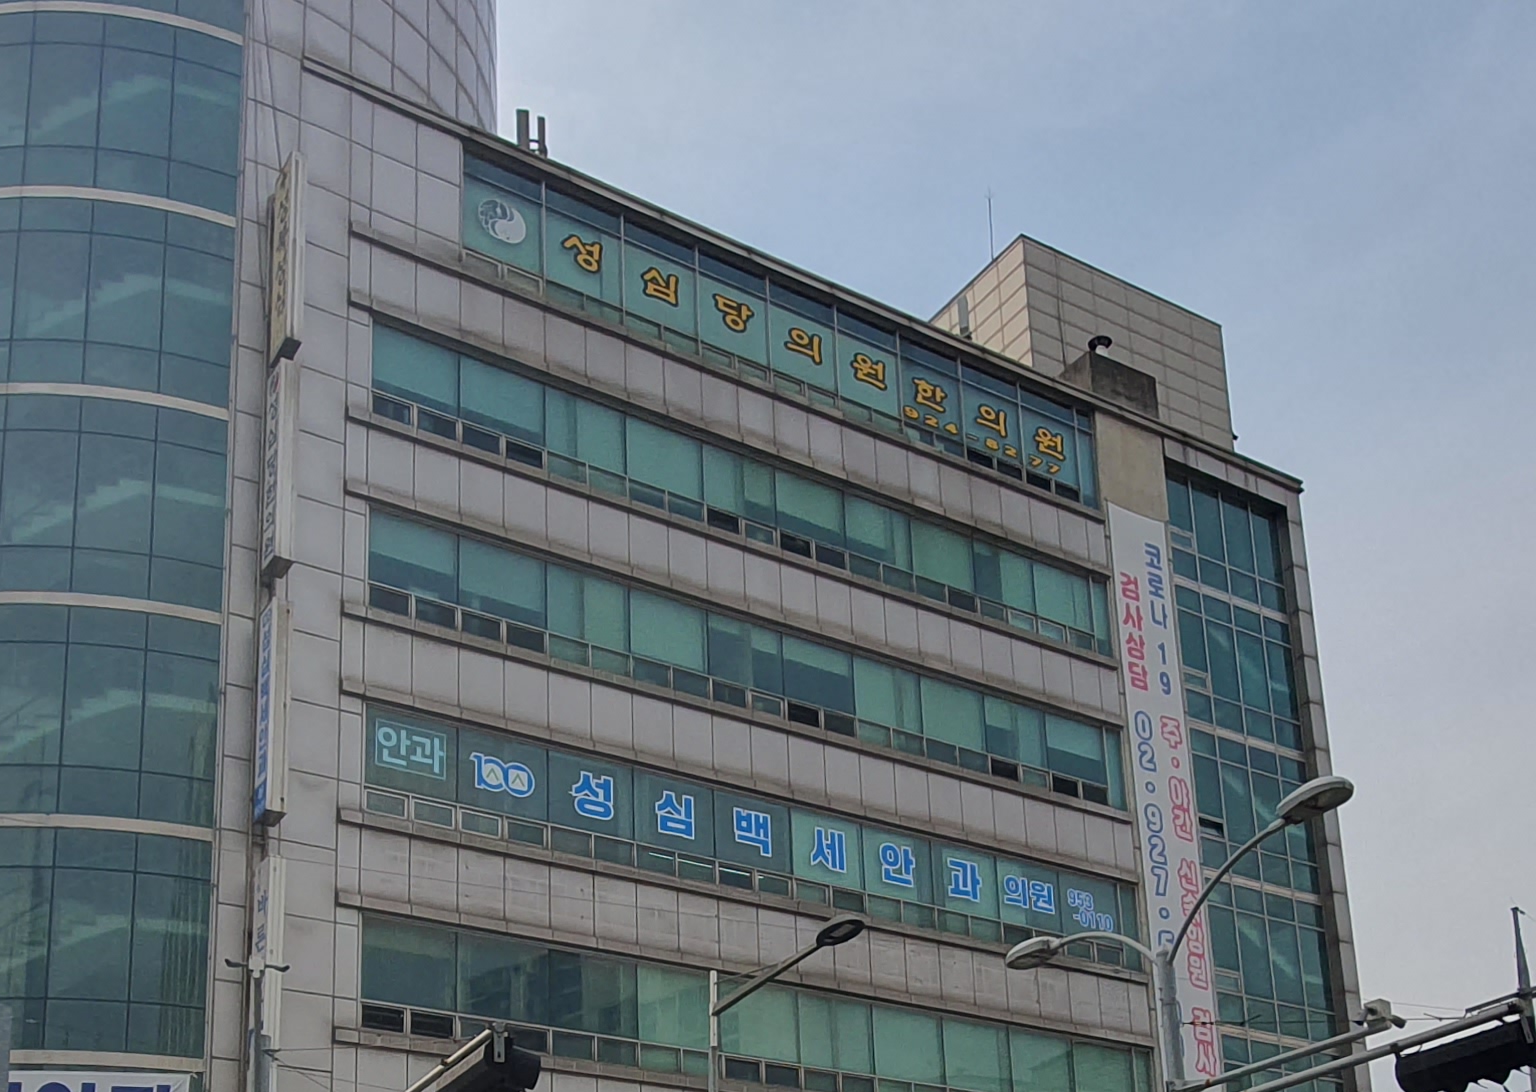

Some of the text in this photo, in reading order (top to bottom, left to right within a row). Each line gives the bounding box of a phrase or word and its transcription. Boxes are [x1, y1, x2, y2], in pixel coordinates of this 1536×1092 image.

[1119, 571, 1149, 692] 검사상담
[1144, 541, 1168, 630] 코로나
[1158, 642, 1172, 696] 19
[376, 726, 445, 777] 안과
[1002, 874, 1056, 914] 의원
[1066, 889, 1095, 913] 953
